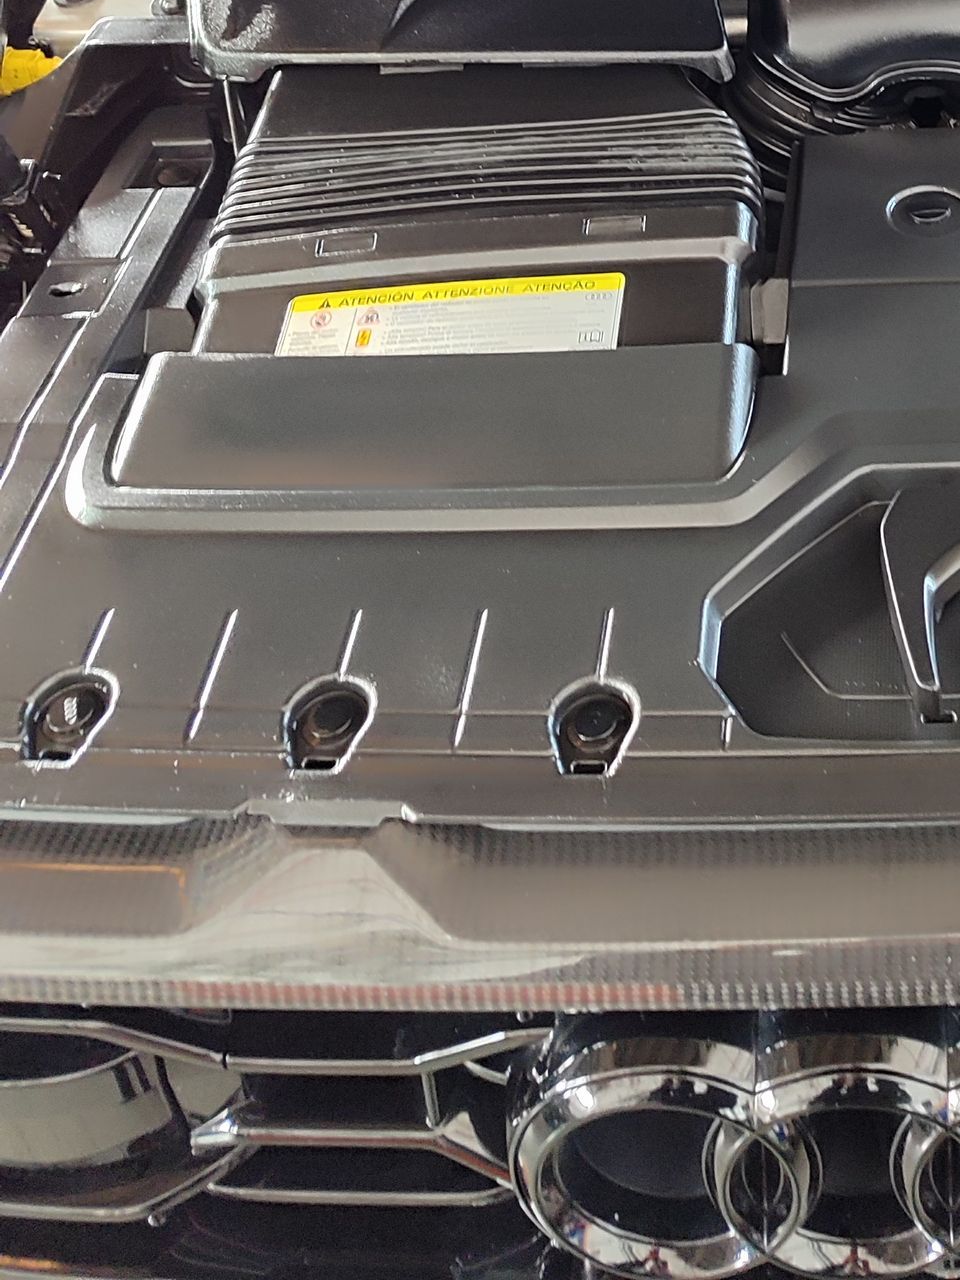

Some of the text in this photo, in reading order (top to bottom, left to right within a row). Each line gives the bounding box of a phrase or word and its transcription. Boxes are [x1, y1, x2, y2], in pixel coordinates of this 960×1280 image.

[339, 280, 596, 307] ATENCIÓN ATTENZIONE ATENÇÃO
